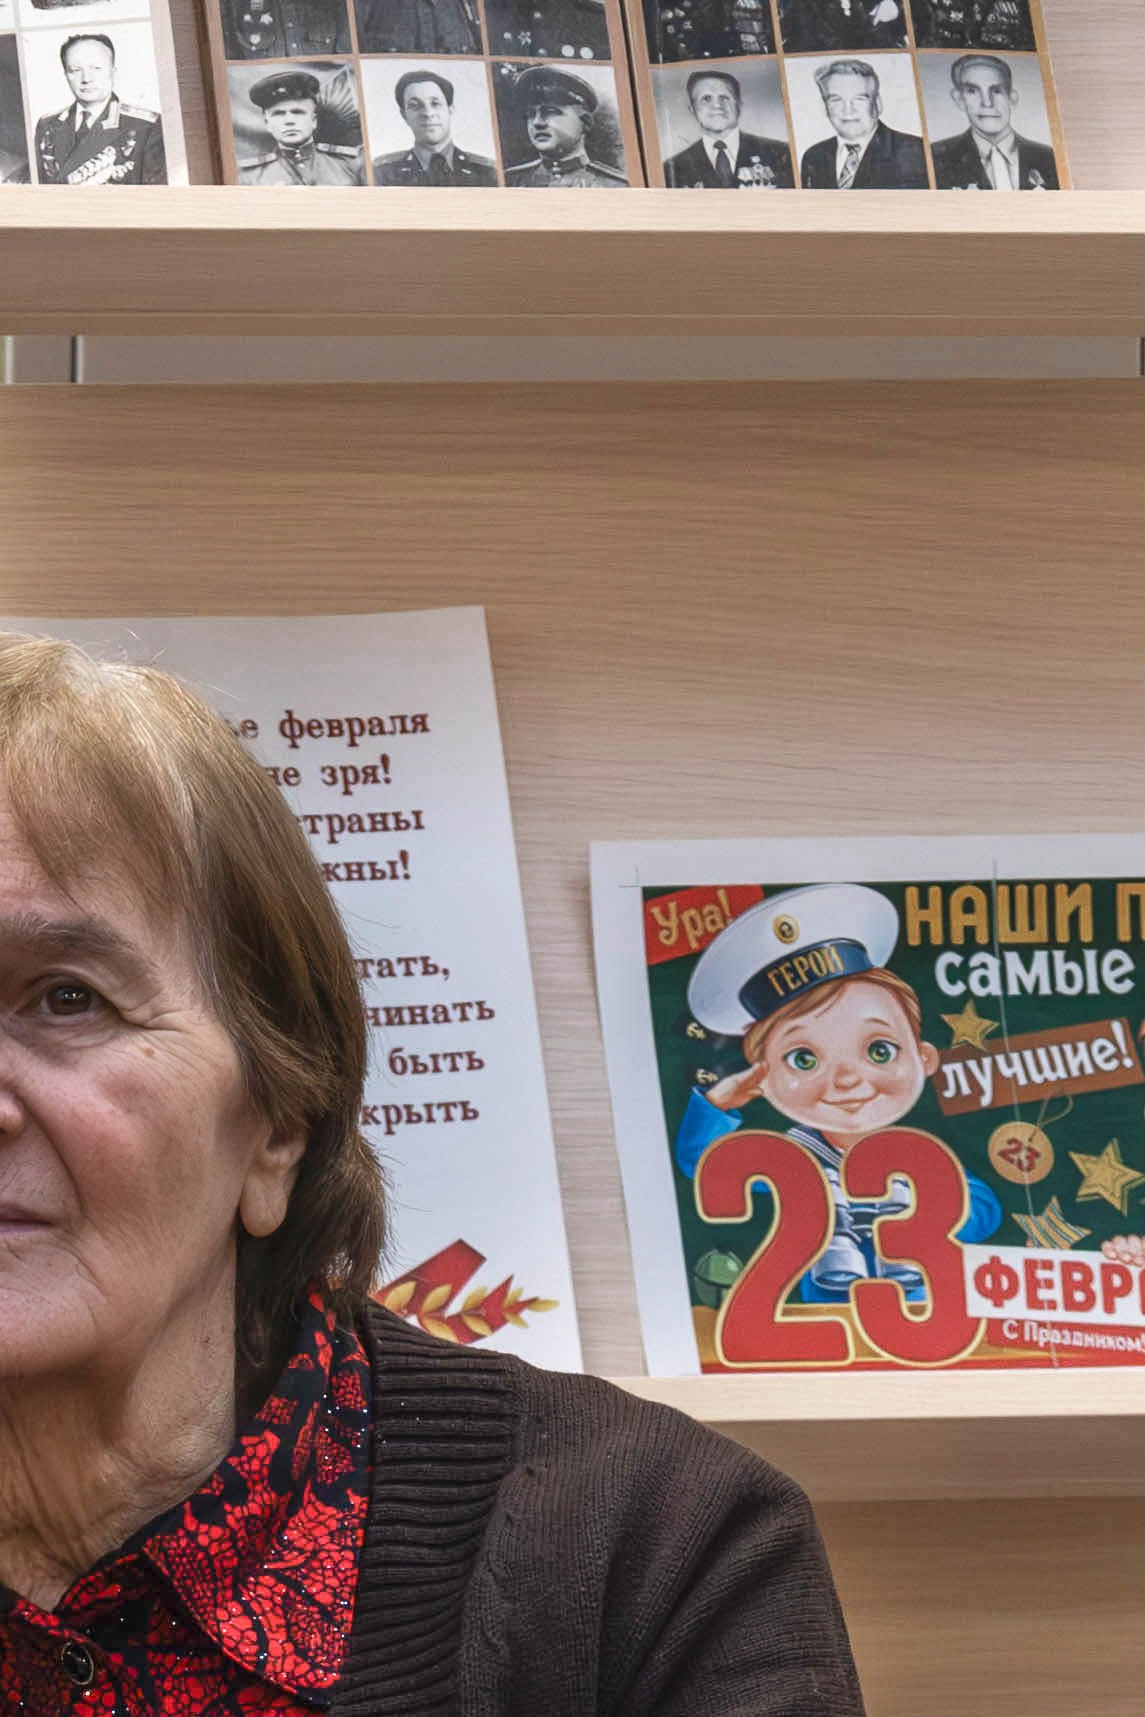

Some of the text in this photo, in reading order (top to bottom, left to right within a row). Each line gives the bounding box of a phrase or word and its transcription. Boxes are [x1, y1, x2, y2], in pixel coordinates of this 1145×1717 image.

[279, 709, 430, 749] февраля
[320, 753, 392, 796] зря!
[296, 809, 425, 844] траны
[650, 888, 734, 949] Ура!
[905, 883, 1093, 946] НАШИ
[935, 948, 1136, 997] самые
[388, 1046, 486, 1075] быть
[941, 1020, 1135, 1107] лучшие!
[997, 1138, 1041, 1173] 23
[694, 1126, 986, 1368] 23
[1002, 1320, 1019, 1340] С
